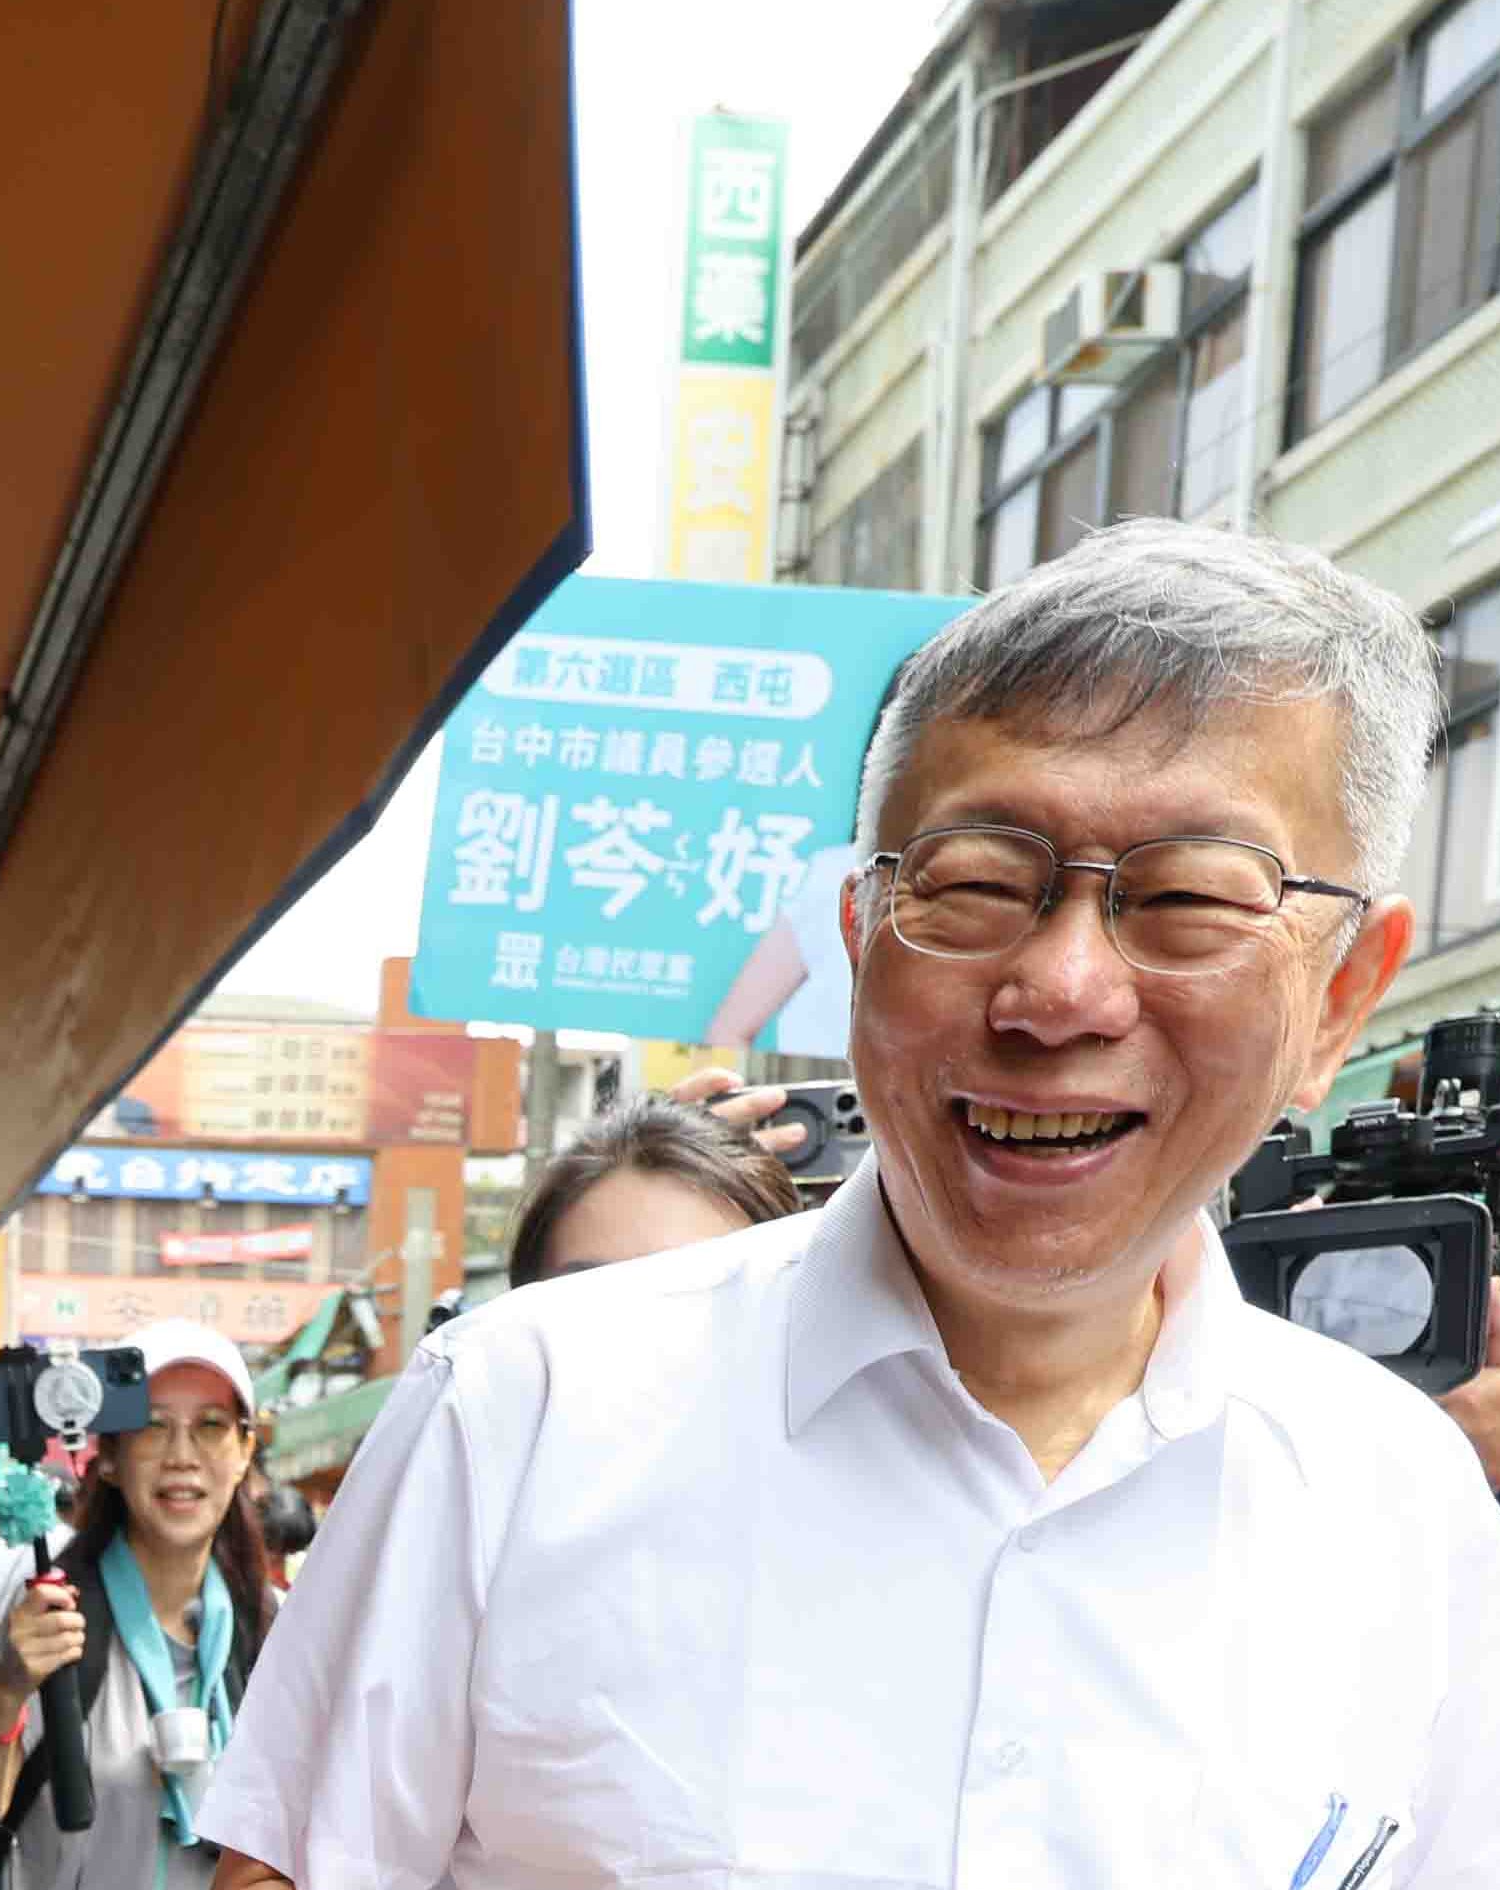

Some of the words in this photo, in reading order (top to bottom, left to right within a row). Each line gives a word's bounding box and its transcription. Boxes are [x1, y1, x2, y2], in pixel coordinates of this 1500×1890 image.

[692, 148, 777, 342] 西藥
[511, 648, 681, 699] 第六選區
[711, 660, 794, 709] 西屯
[470, 719, 824, 788] 台中市議員參選人
